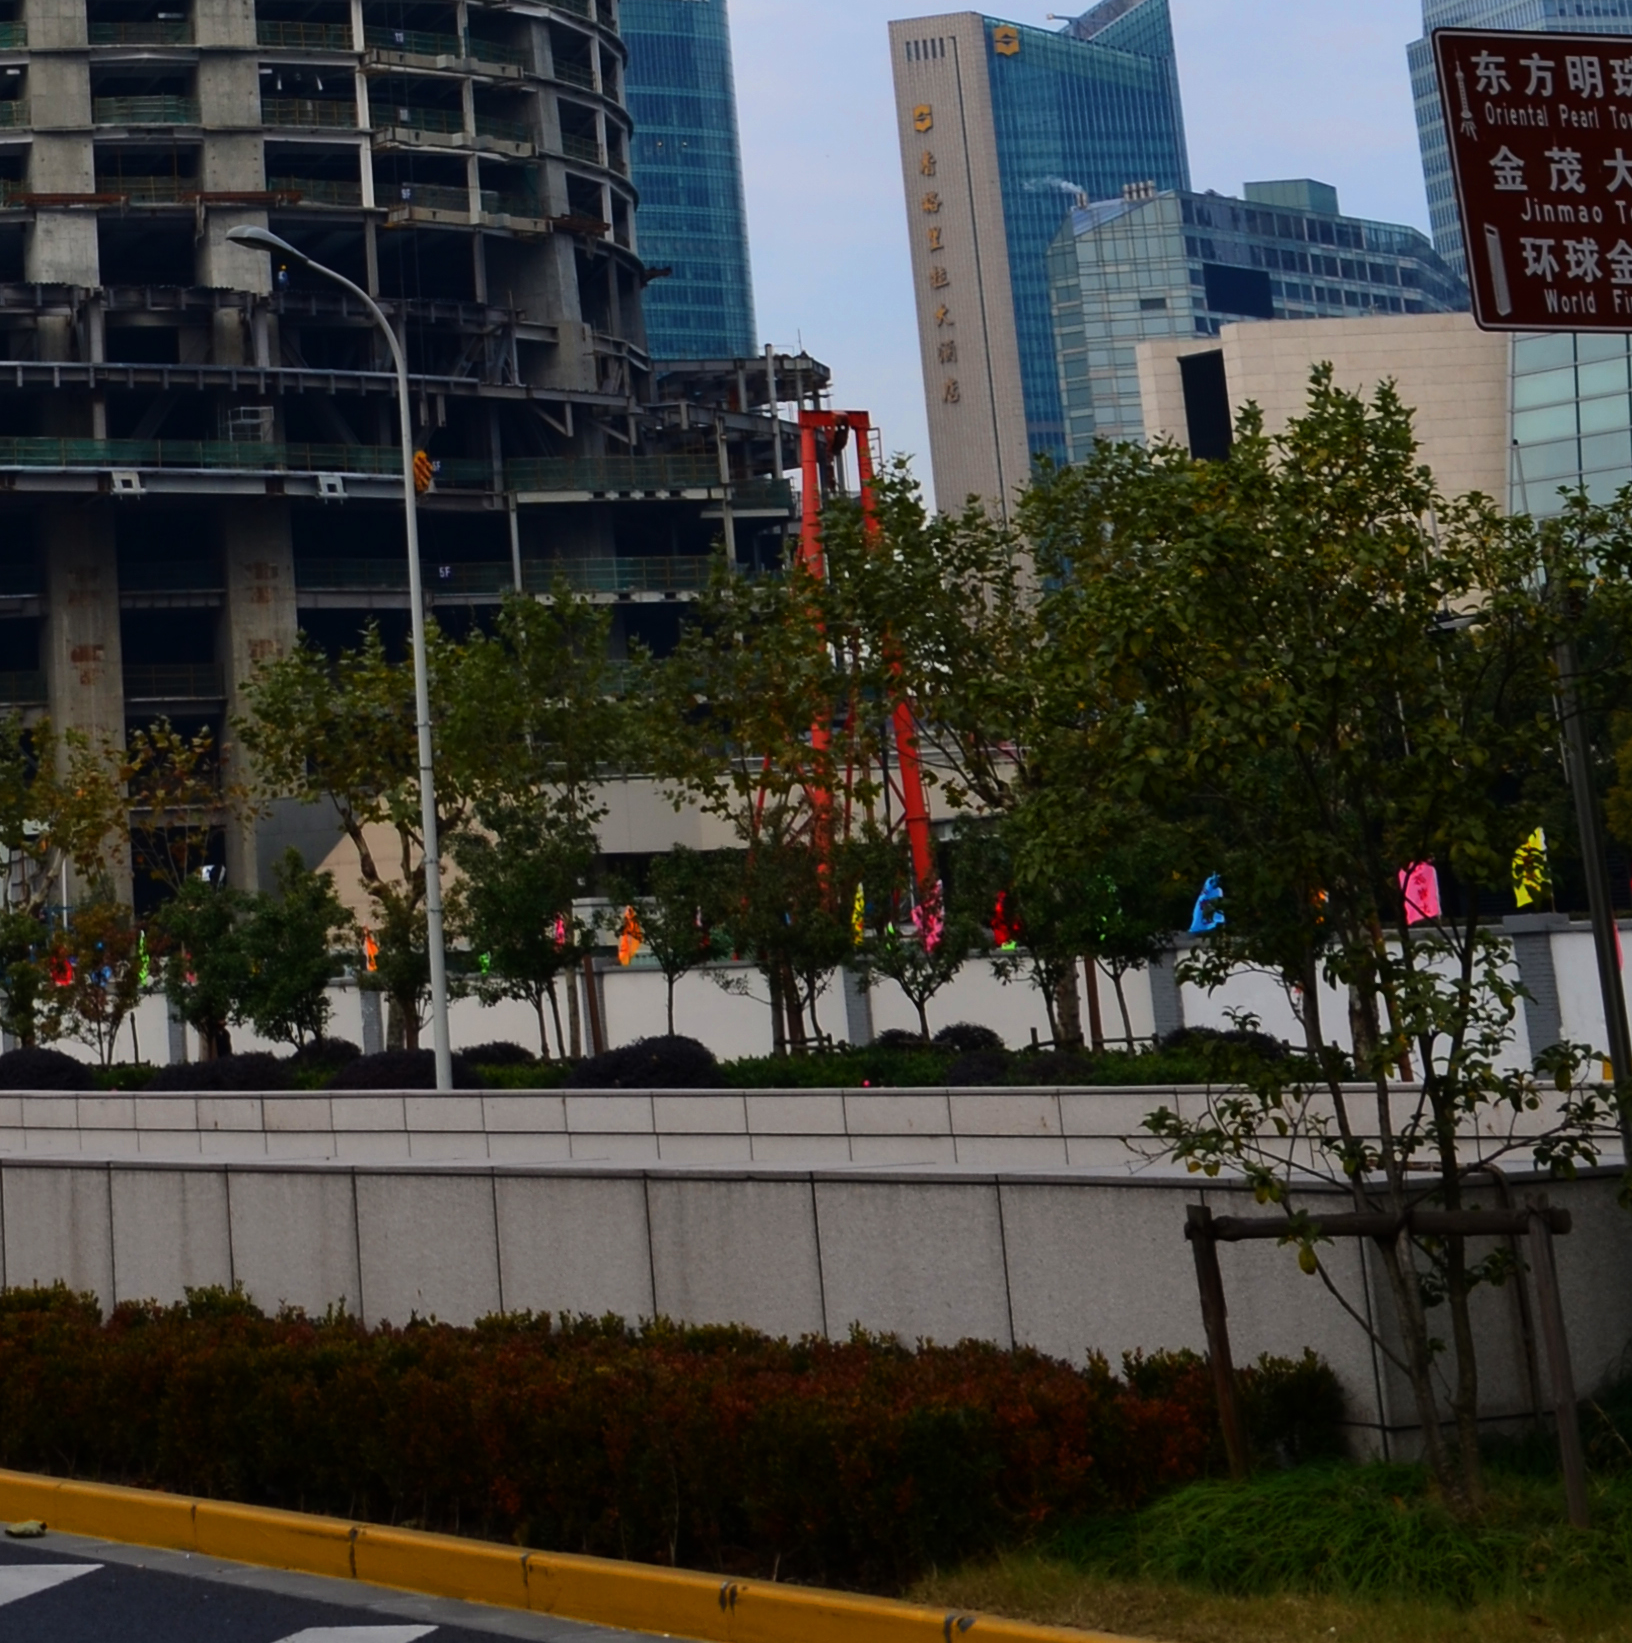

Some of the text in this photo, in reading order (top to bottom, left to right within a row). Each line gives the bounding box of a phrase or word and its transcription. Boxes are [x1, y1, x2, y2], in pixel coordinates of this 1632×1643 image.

[1485, 101, 1549, 127] Oriental
[1558, 103, 1600, 129] Pearl
[1488, 145, 1632, 194] 金茂大
[1520, 196, 1632, 225] Jinmao T
[920, 150, 960, 404] 香格里拉大酒店
[1519, 236, 1632, 283] 环球金
[1544, 288, 1632, 314] World Fi
